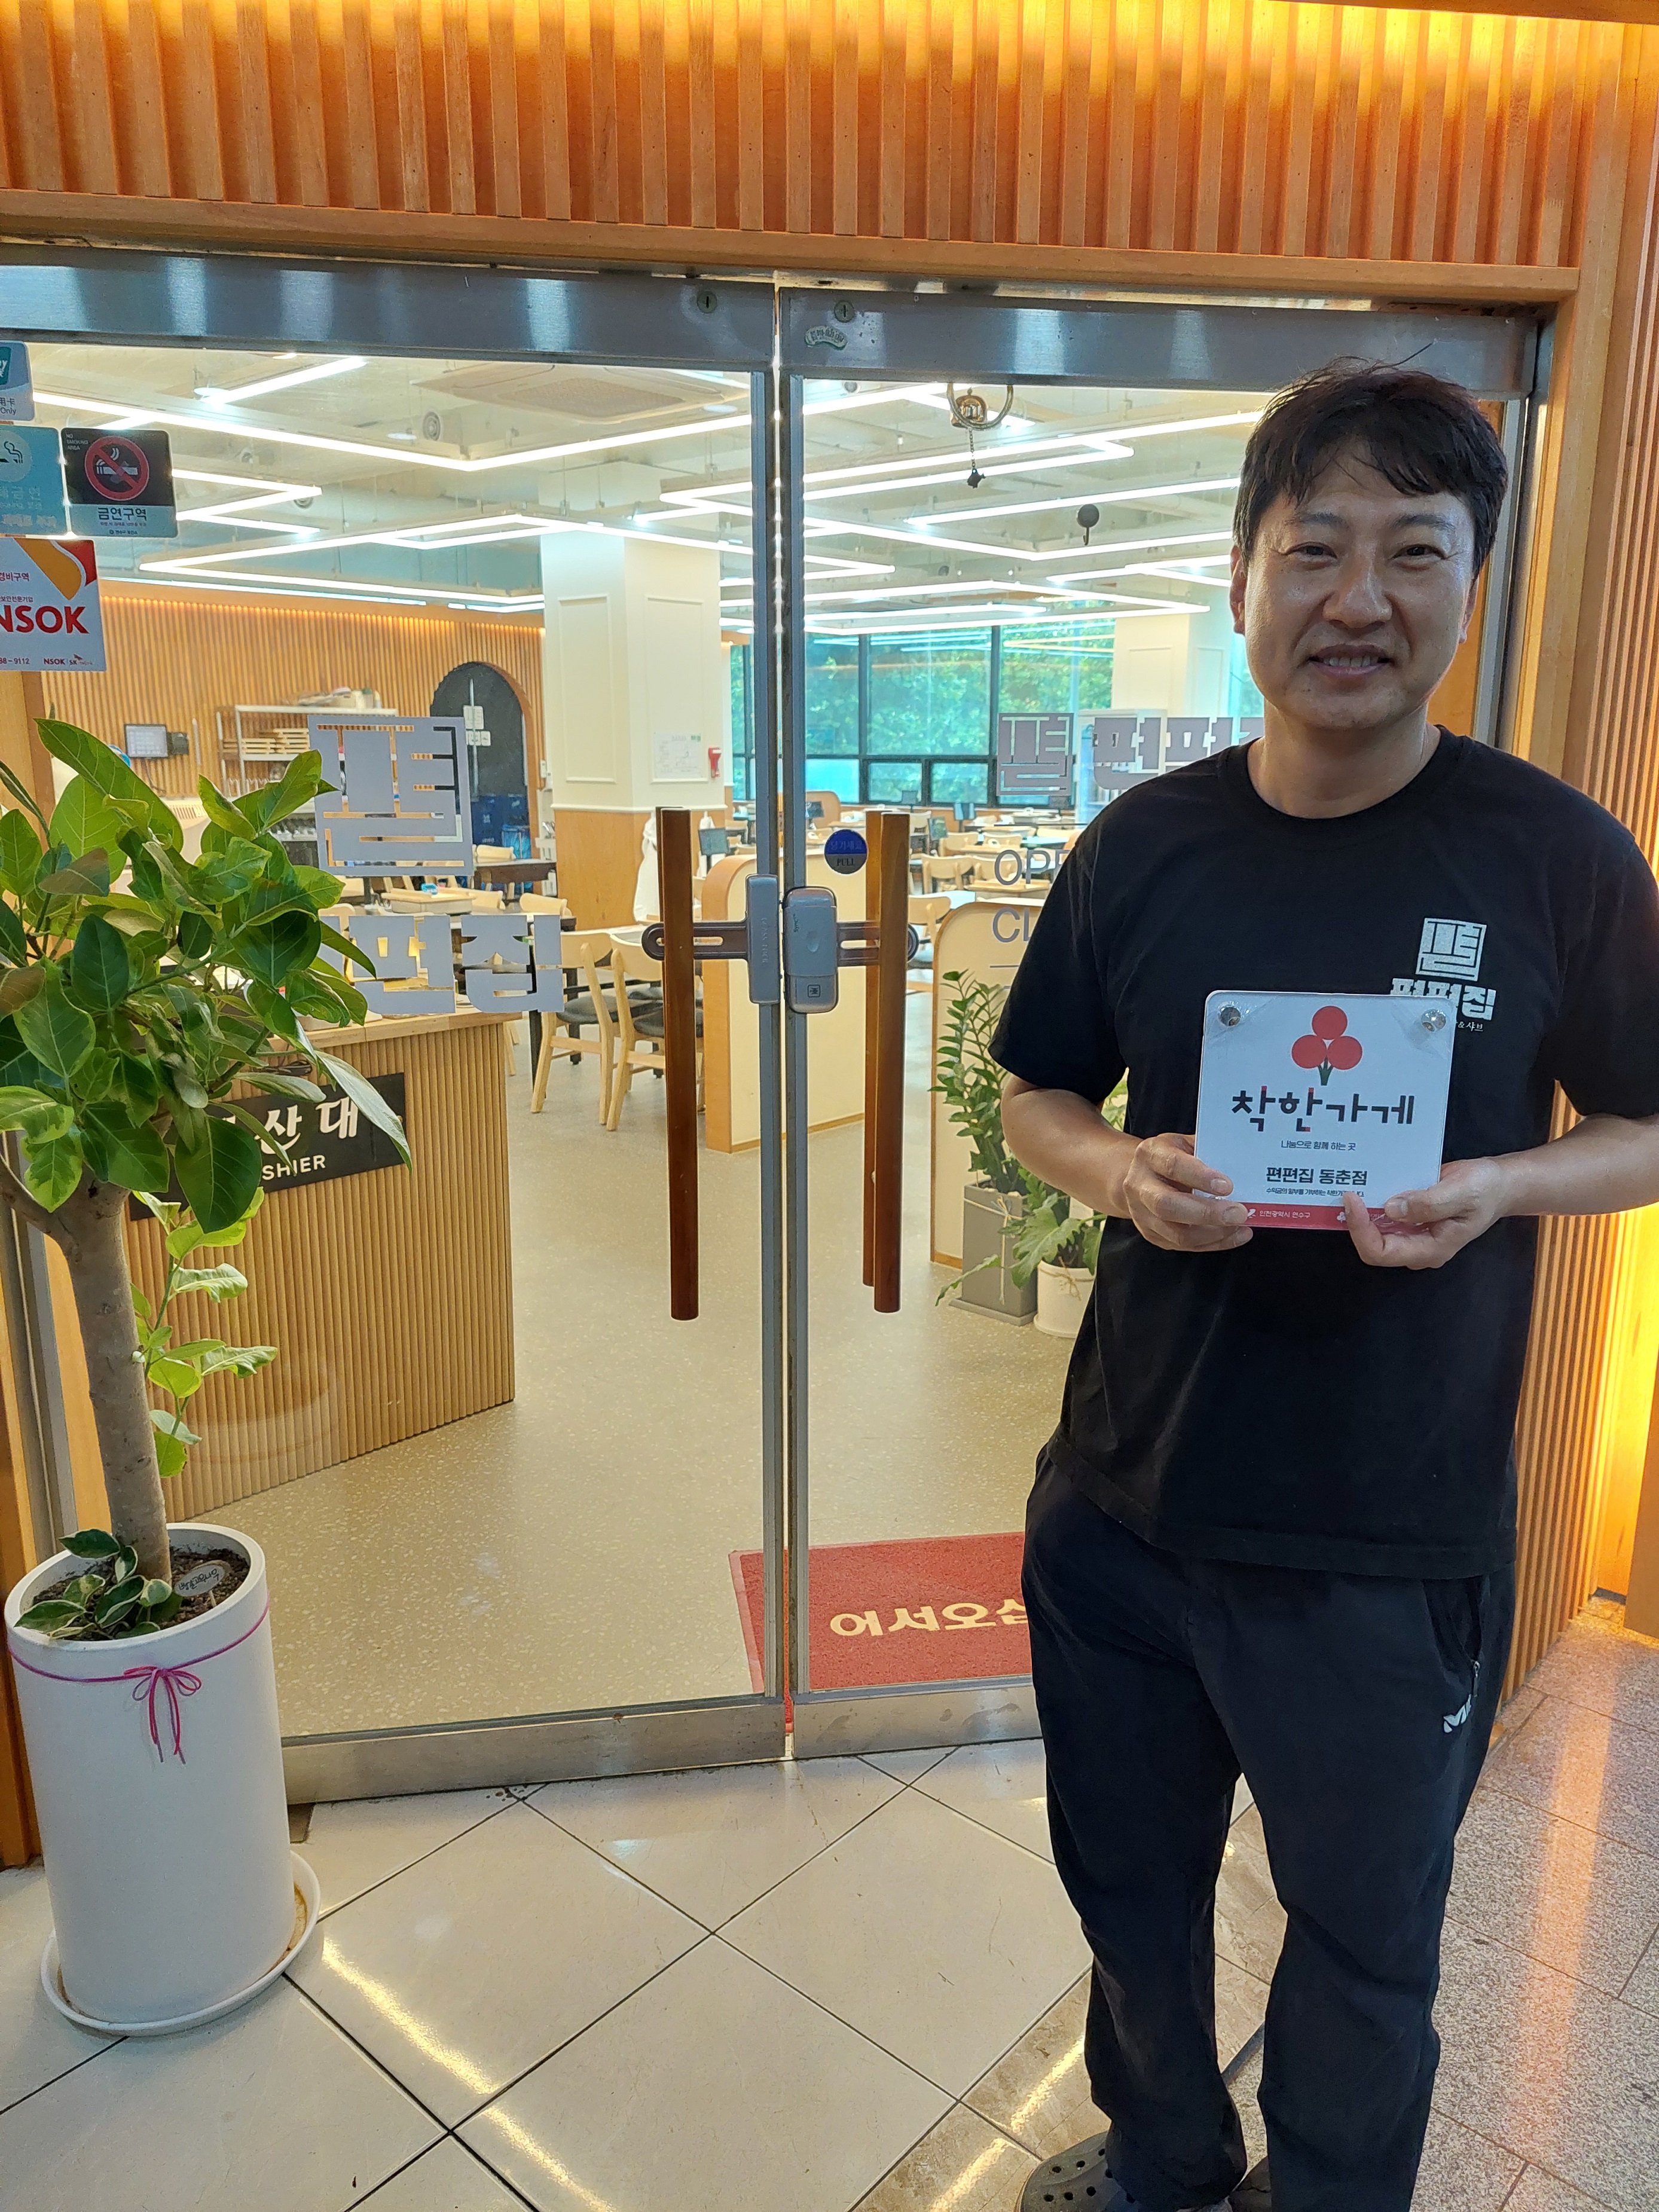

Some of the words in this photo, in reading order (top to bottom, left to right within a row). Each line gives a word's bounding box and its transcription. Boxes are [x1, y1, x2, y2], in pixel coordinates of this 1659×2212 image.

[0, 407, 16, 415] Only
[98, 507, 146, 521] 금연구역
[0, 605, 90, 634] NSOK
[1232, 1086, 1415, 1132] 착한가게
[1281, 1140, 1312, 1149] 나눔으로
[1313, 1141, 1328, 1150] 함께
[1331, 1142, 1346, 1151] 하는
[1348, 1142, 1356, 1151] 곳
[261, 1154, 326, 1180] SHIER
[1266, 1167, 1314, 1183] 편편집
[1319, 1169, 1368, 1186] 동춘점
